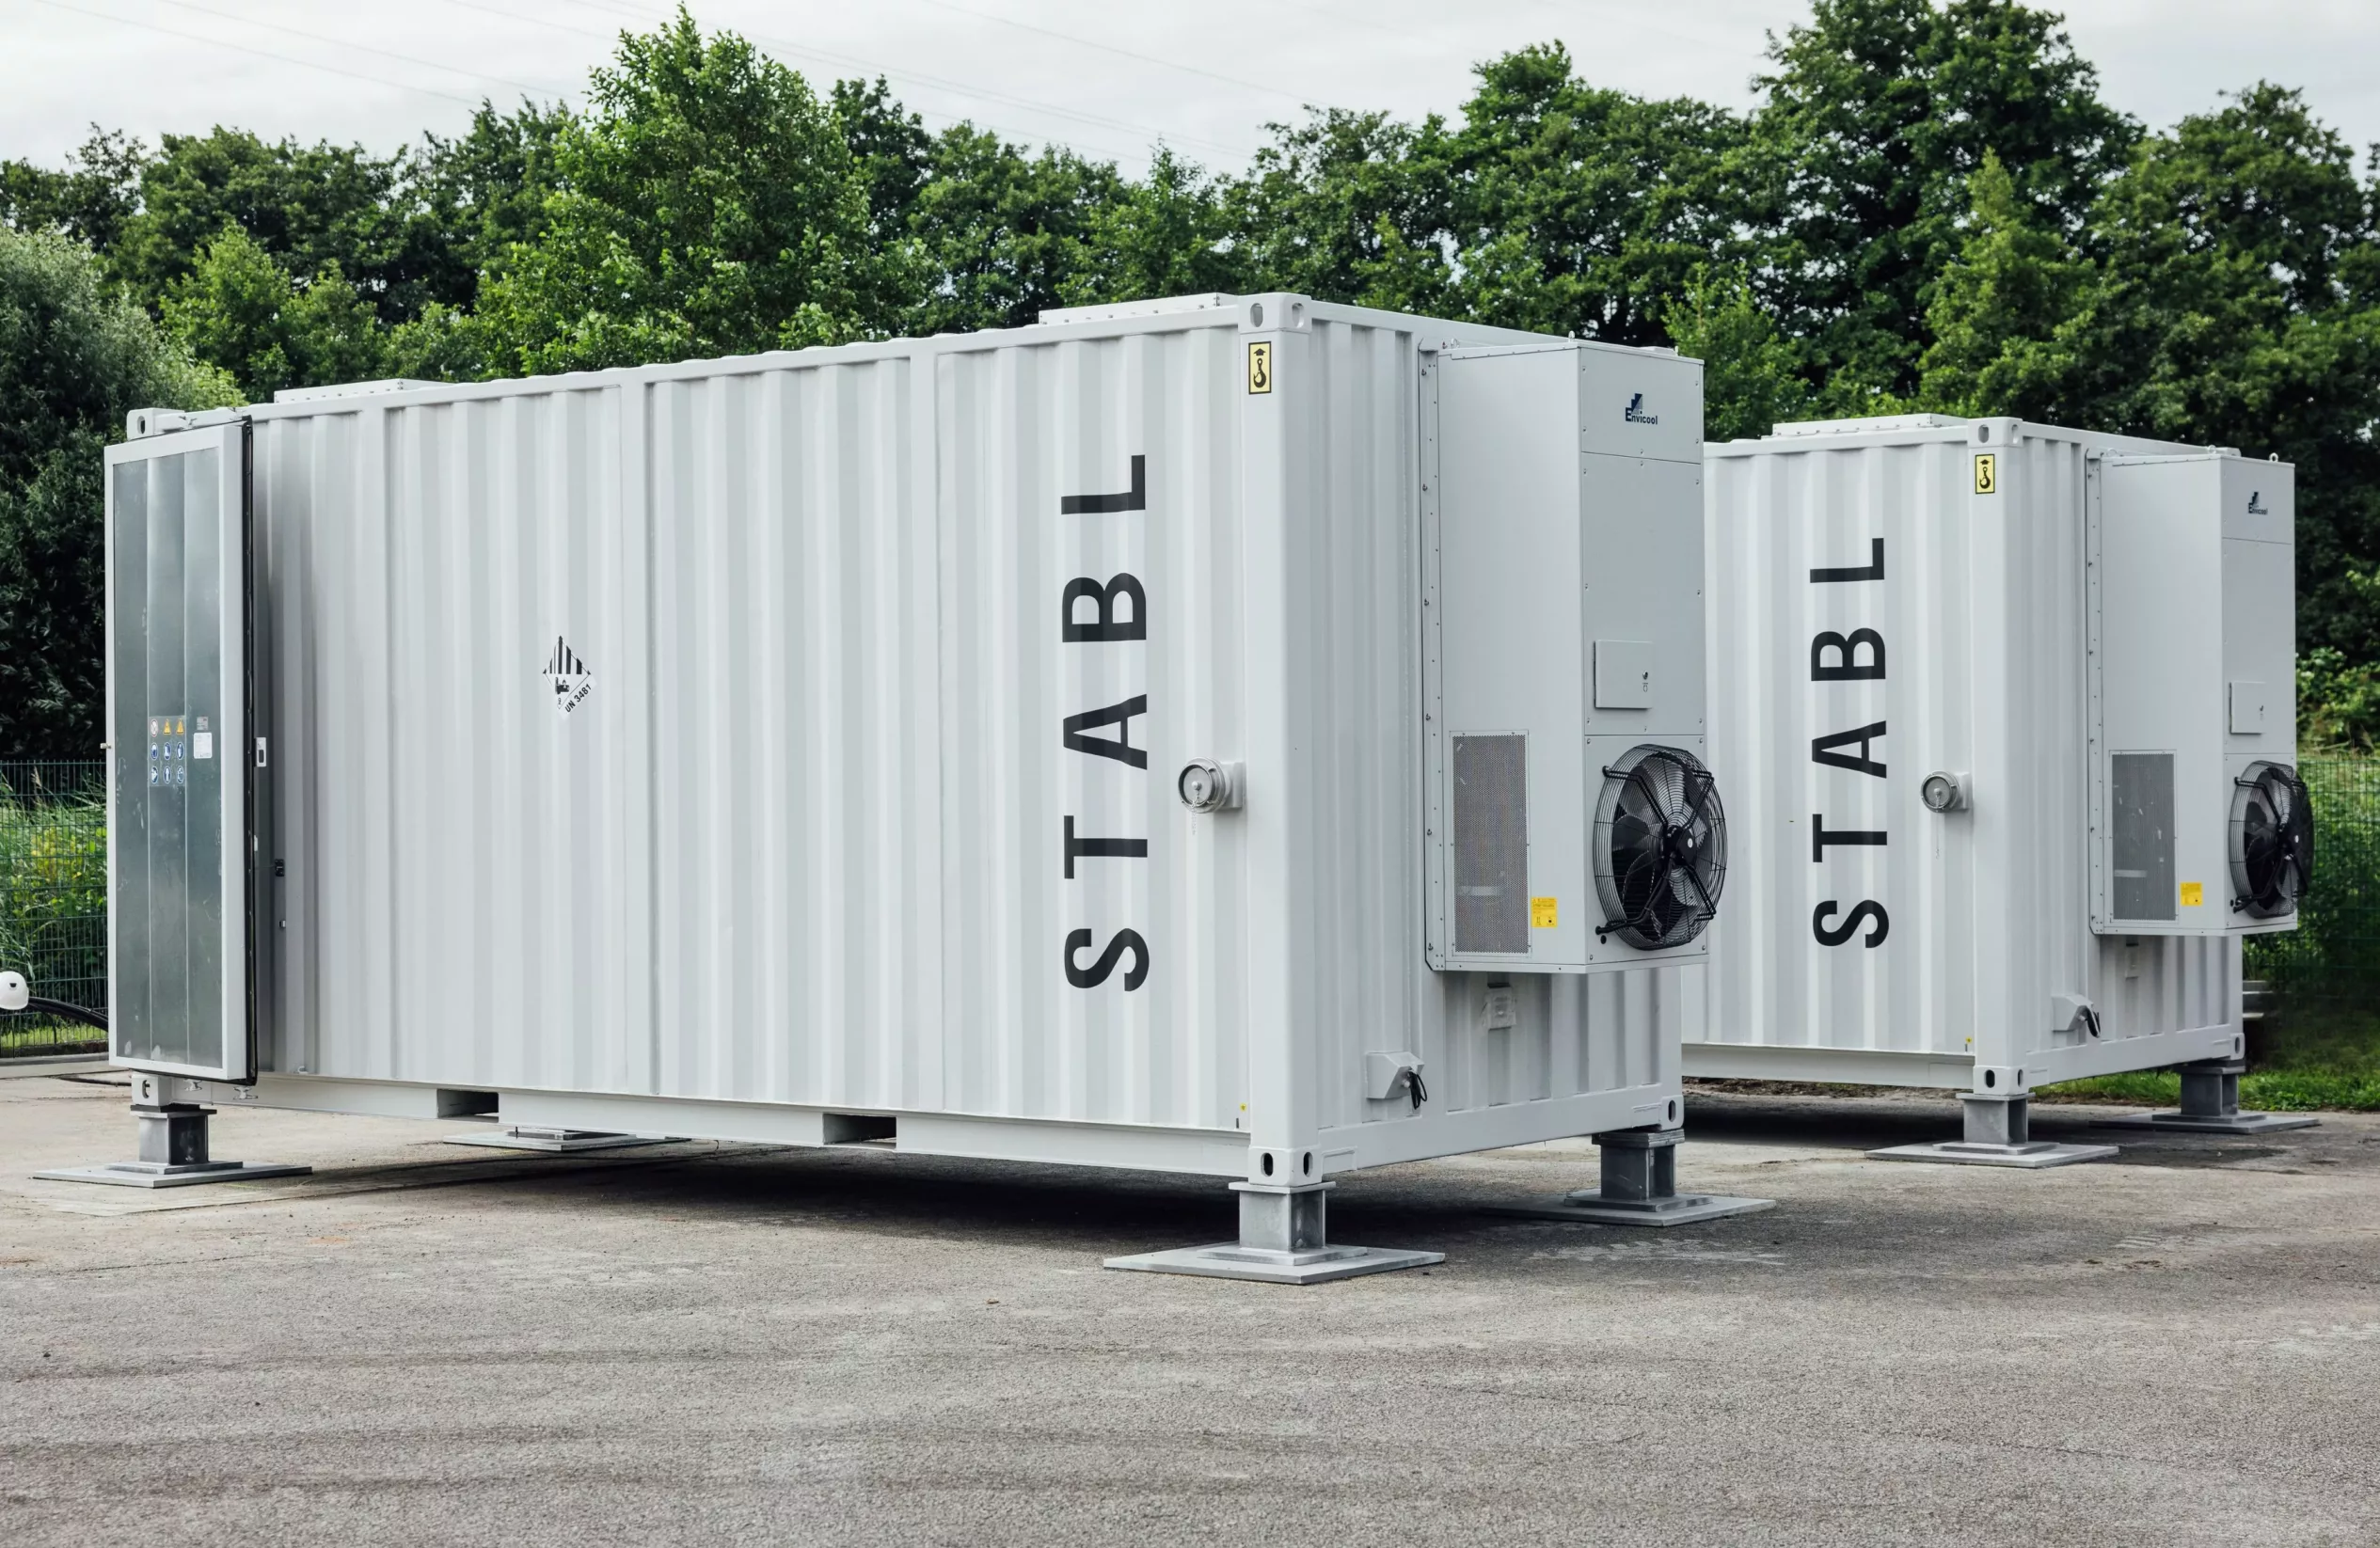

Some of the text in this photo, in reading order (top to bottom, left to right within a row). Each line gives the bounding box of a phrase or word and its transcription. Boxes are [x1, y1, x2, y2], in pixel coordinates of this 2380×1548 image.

[1626, 407, 1658, 425] Envicool
[564, 684, 592, 713] UN 3481
[1061, 454, 1150, 992] STABL
[1810, 538, 1889, 948] STABL
